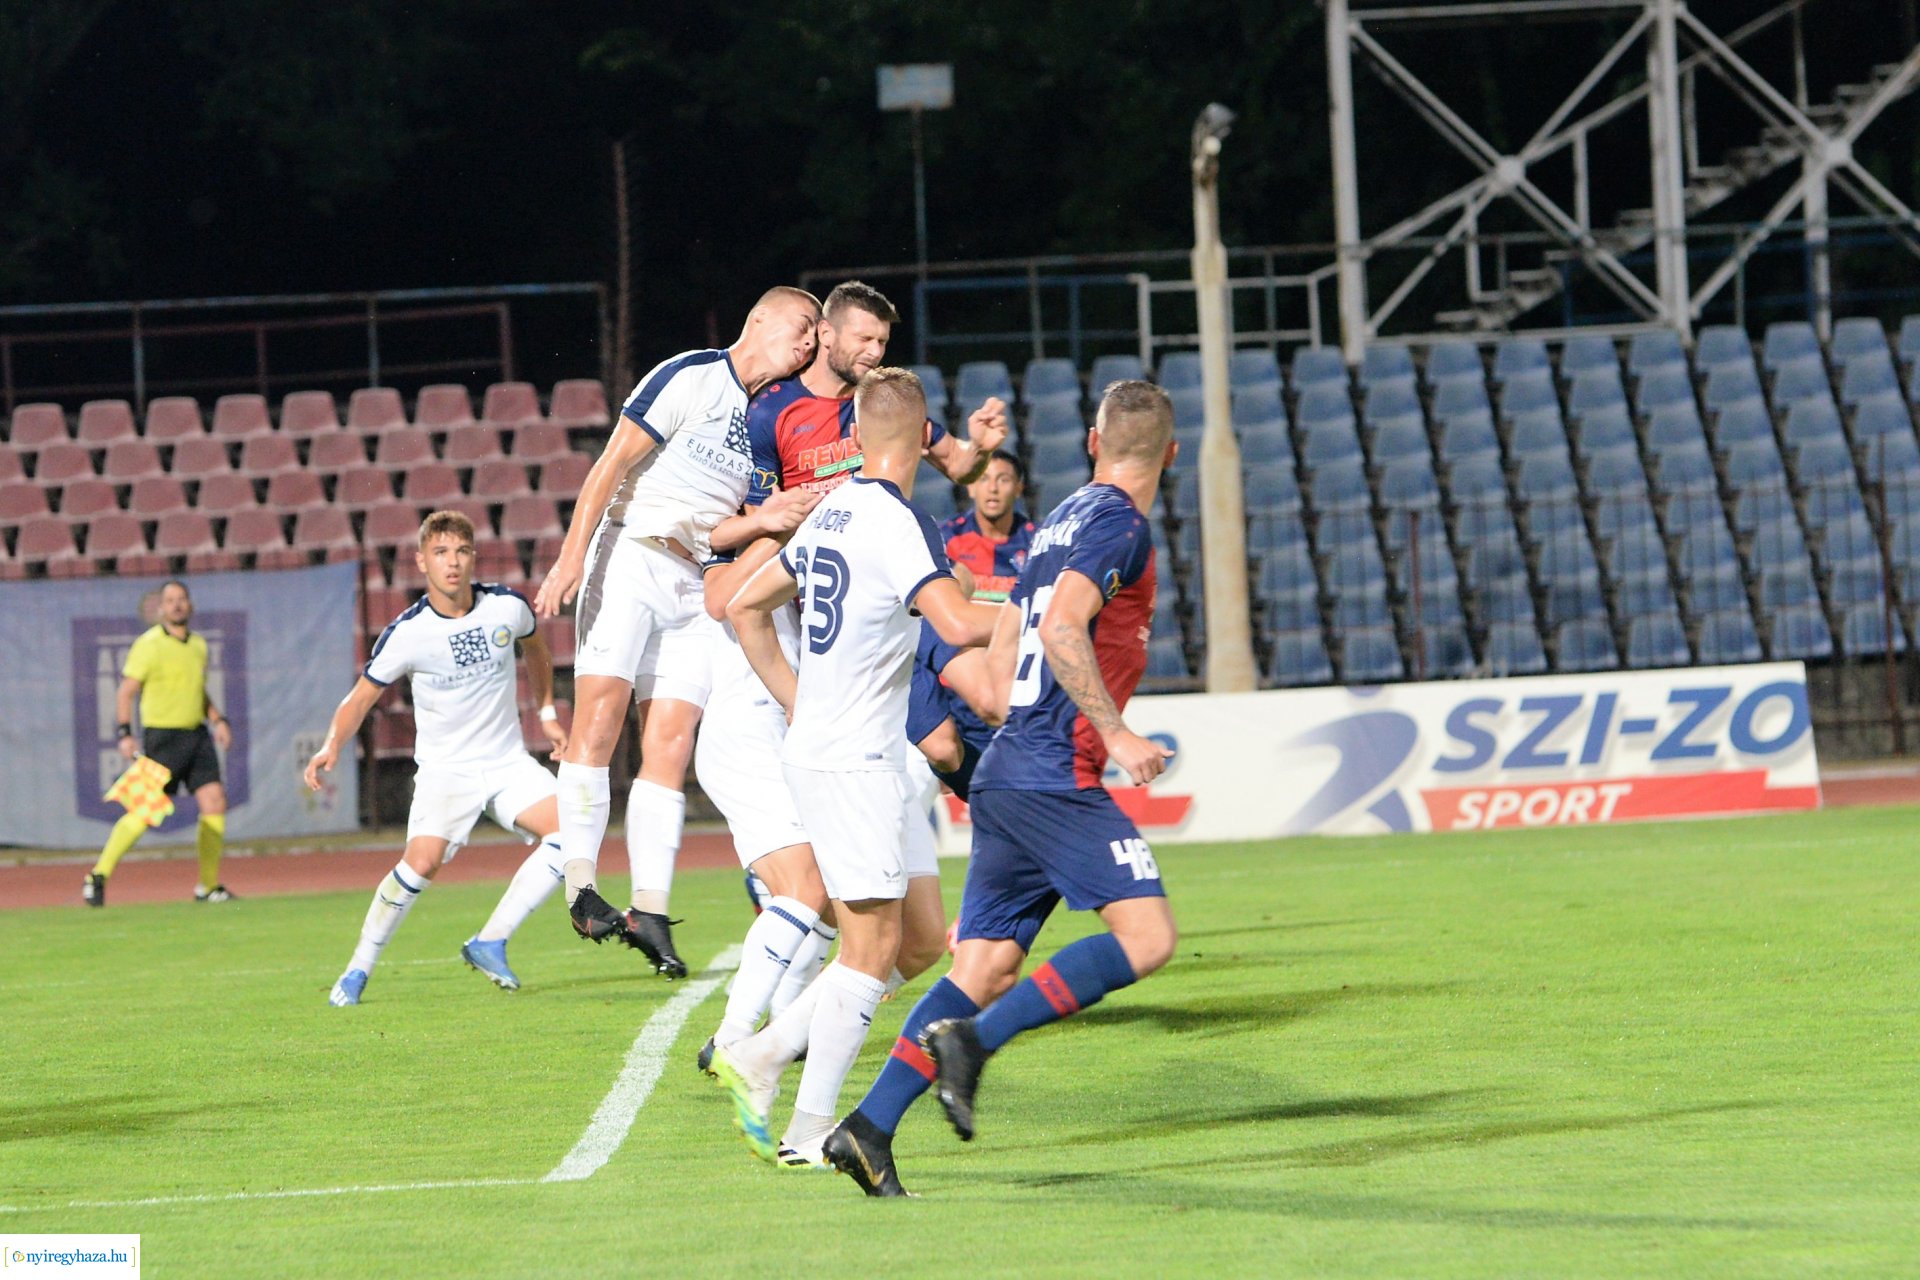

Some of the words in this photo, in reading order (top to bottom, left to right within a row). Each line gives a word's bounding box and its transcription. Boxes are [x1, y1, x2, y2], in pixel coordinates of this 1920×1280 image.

[1432, 681, 1812, 772] SZI-ZO
[1452, 784, 1633, 830] SPORT
[1109, 838, 1159, 880] 48
